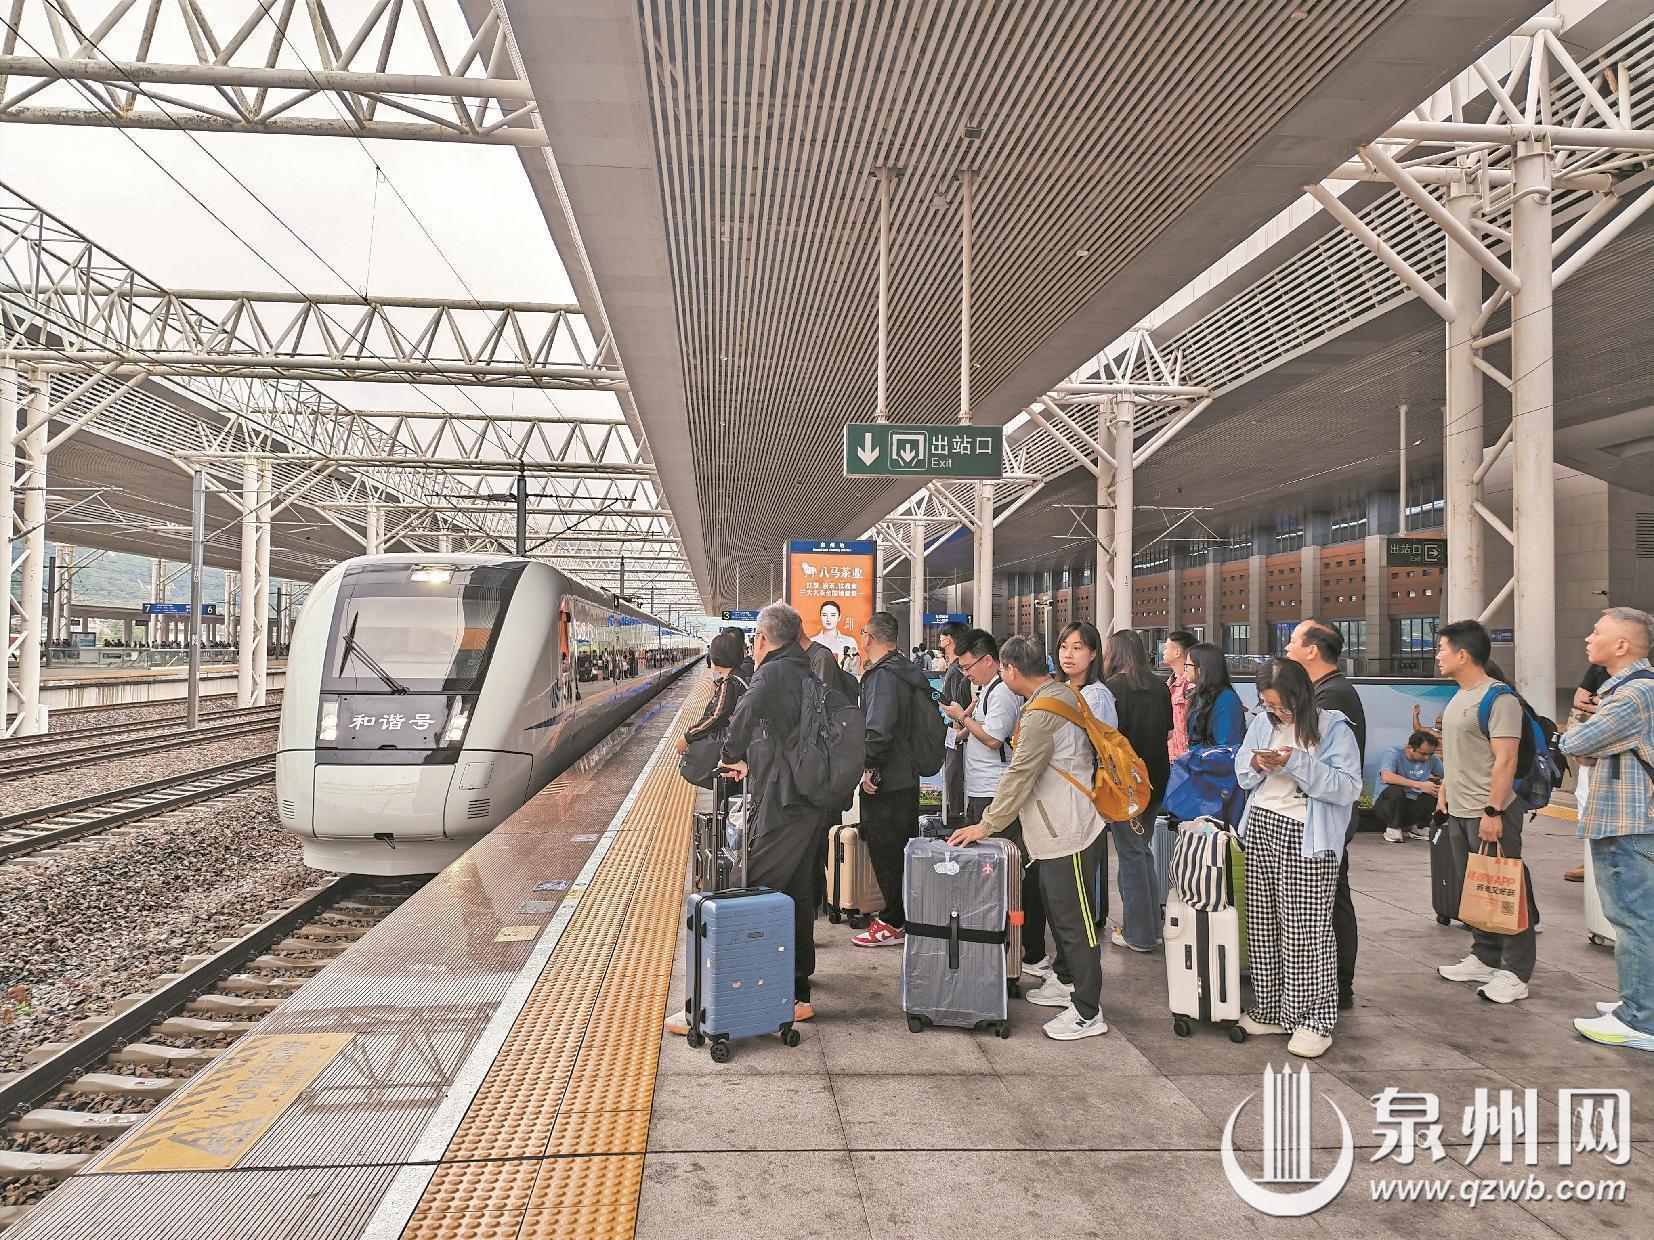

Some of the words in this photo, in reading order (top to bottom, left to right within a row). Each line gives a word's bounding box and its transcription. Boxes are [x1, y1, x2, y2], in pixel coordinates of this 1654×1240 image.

[931, 434, 993, 455] 出站口
[931, 457, 952, 468] Exit
[1390, 543, 1422, 554] 出站口
[819, 566, 863, 579] 八马茶业
[144, 604, 151, 613] 7
[207, 605, 213, 614] 6
[723, 611, 730, 620] 3
[349, 713, 436, 731] 和谐号
